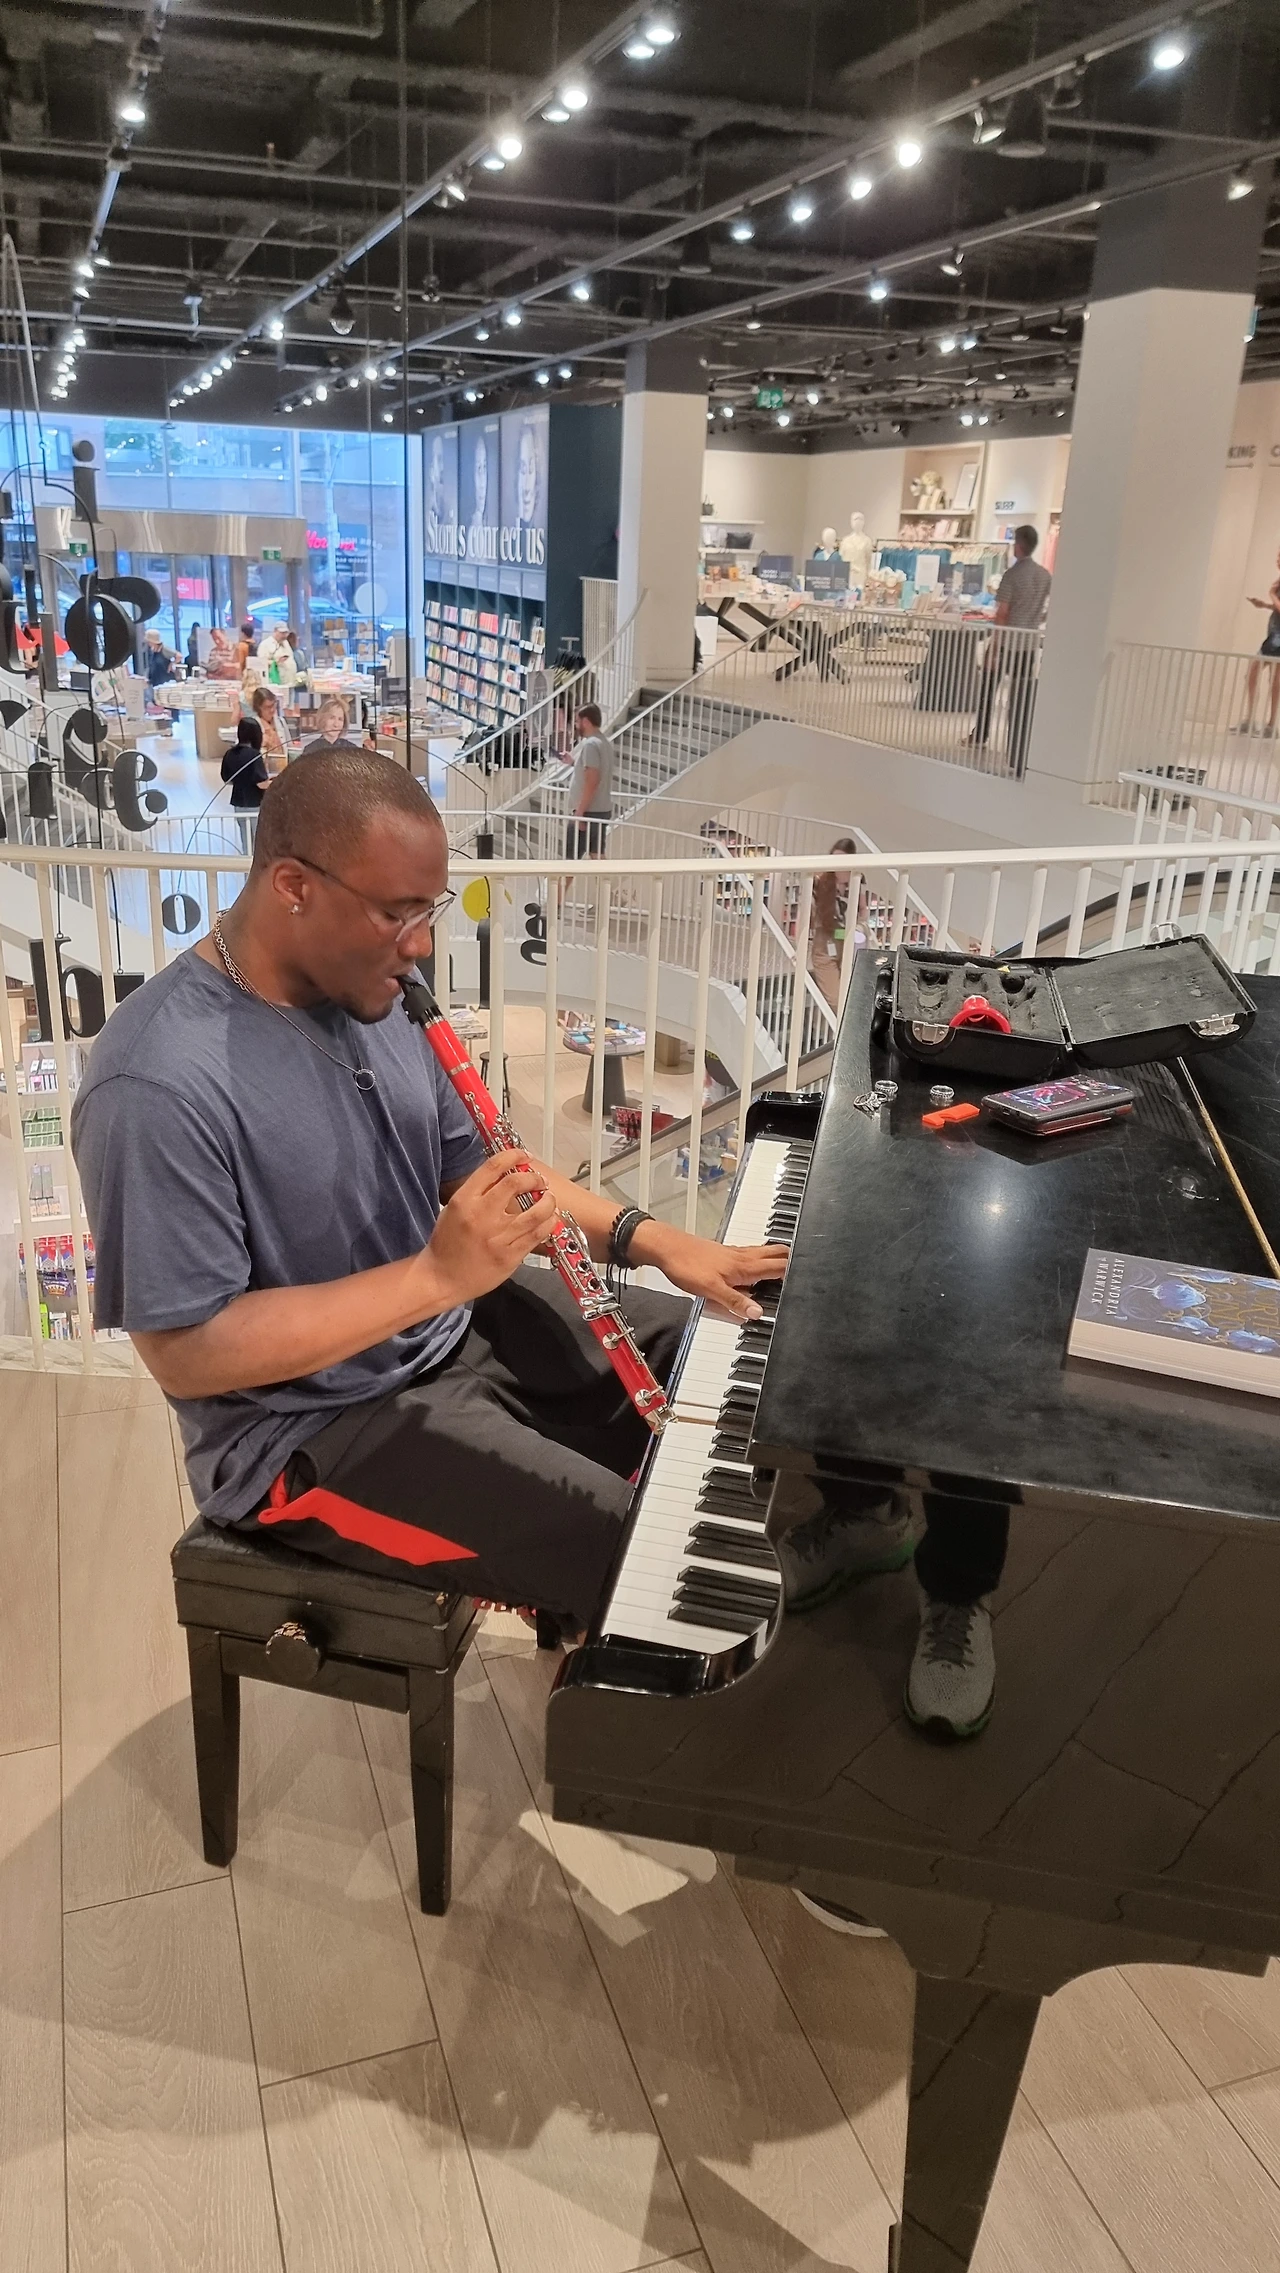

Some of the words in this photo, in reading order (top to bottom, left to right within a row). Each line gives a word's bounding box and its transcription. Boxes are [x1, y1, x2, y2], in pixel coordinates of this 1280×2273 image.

[525, 527, 545, 566] us
[1091, 1263, 1109, 1305] WARWICK
[1106, 1258, 1125, 1316] ALEXANDRIA
